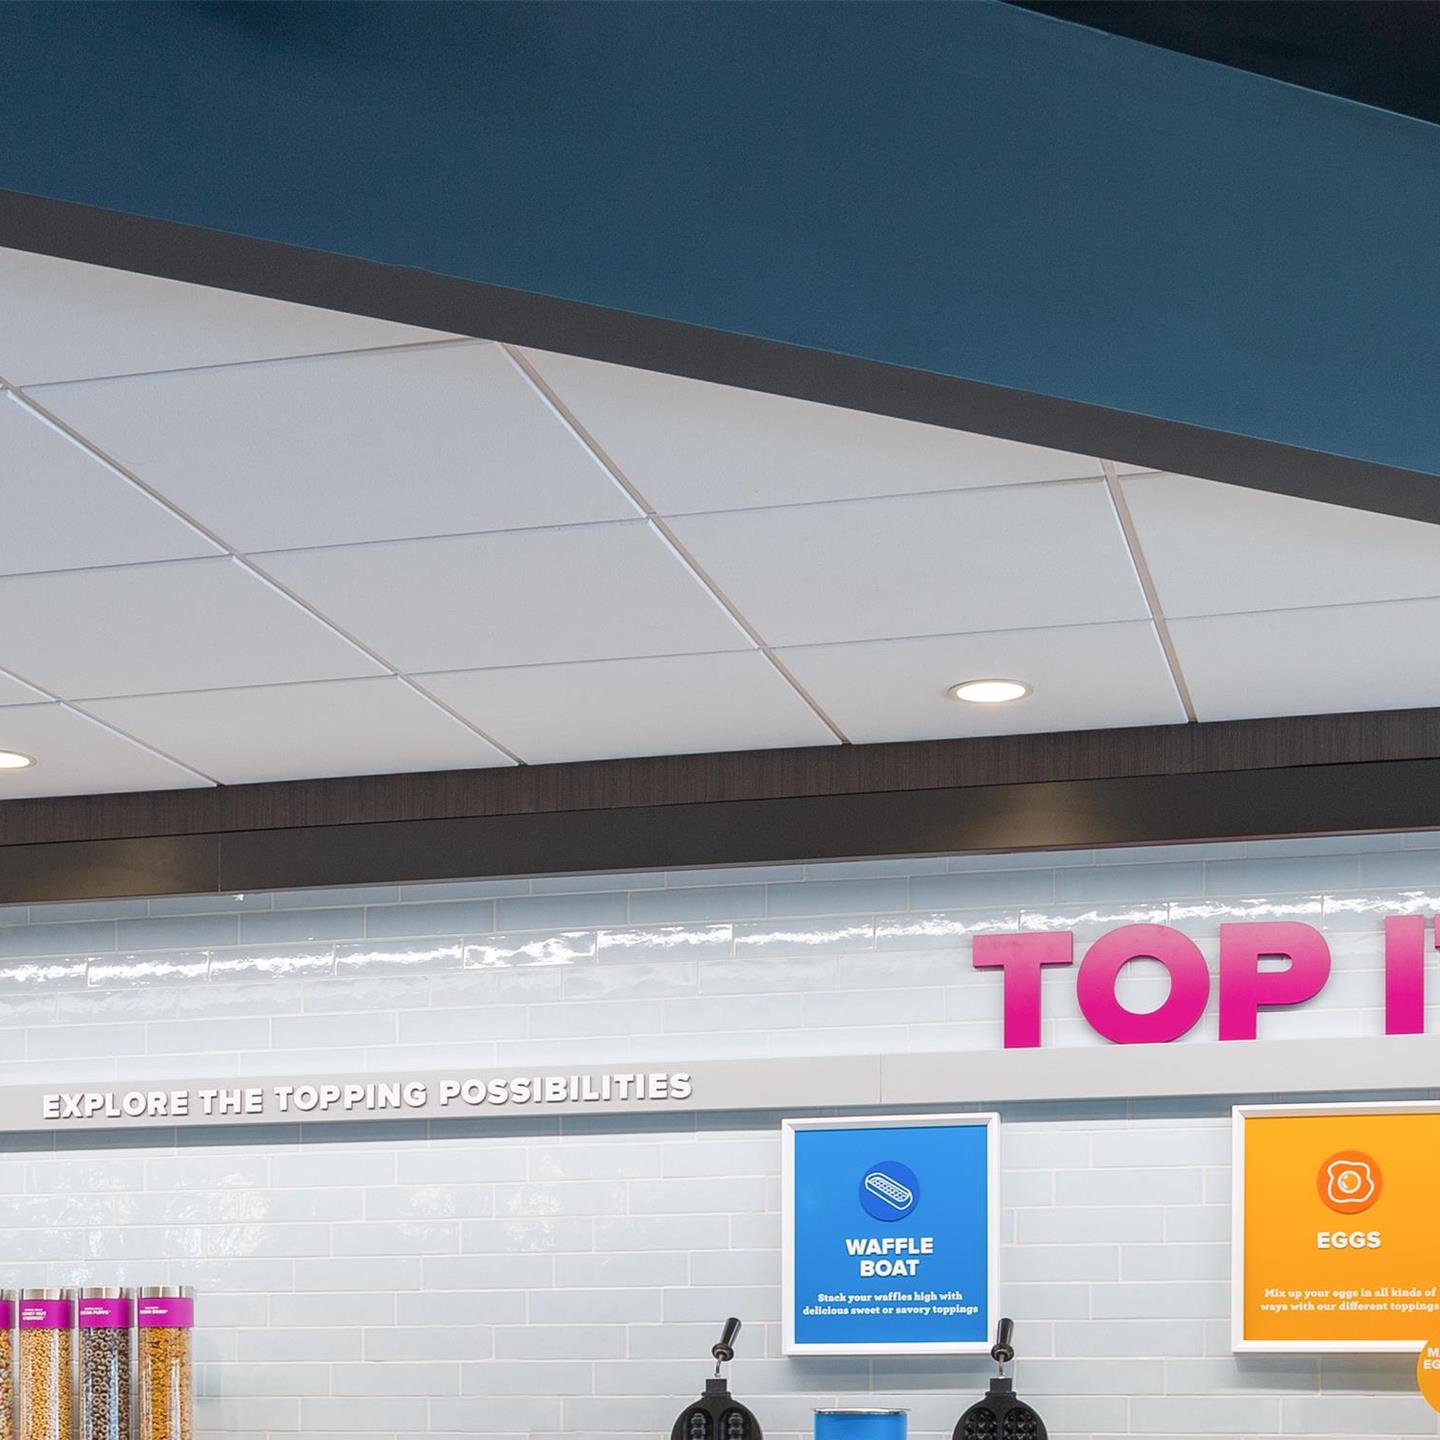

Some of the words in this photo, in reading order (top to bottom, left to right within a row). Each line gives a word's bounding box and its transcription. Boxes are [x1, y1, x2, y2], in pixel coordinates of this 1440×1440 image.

[972, 921, 1332, 1049] TOP
[42, 1090, 190, 1120] EXPLORE
[198, 1087, 264, 1116] THE
[273, 1082, 428, 1112] TOPPING
[439, 1072, 693, 1106] POSSIBILITIES
[845, 1237, 934, 1256] WAFFLE
[1316, 1231, 1382, 1250] EGGS
[859, 1259, 920, 1278] BOAT
[817, 1292, 847, 1303] Stack
[847, 1294, 872, 1304] your
[873, 1292, 912, 1302] waffles
[913, 1291, 938, 1302] high
[939, 1290, 963, 1301] with
[1264, 1287, 1287, 1298] Mix
[1288, 1289, 1302, 1300] up
[1303, 1289, 1331, 1300] your
[1332, 1289, 1359, 1300] eggs
[1361, 1287, 1372, 1298] in
[1374, 1287, 1389, 1298] all
[1390, 1286, 1422, 1298] kinds
[1424, 1286, 1437, 1297] of
[802, 1305, 849, 1316] delicious
[850, 1306, 881, 1315] sweet
[882, 1306, 894, 1315] or
[895, 1305, 931, 1316] savory
[932, 1304, 979, 1316] toppings
[1260, 1302, 1288, 1313] ways
[1290, 1301, 1315, 1311] with
[1317, 1302, 1337, 1311] our
[1338, 1301, 1389, 1311] different
[1389, 1300, 1440, 1313] toppings
